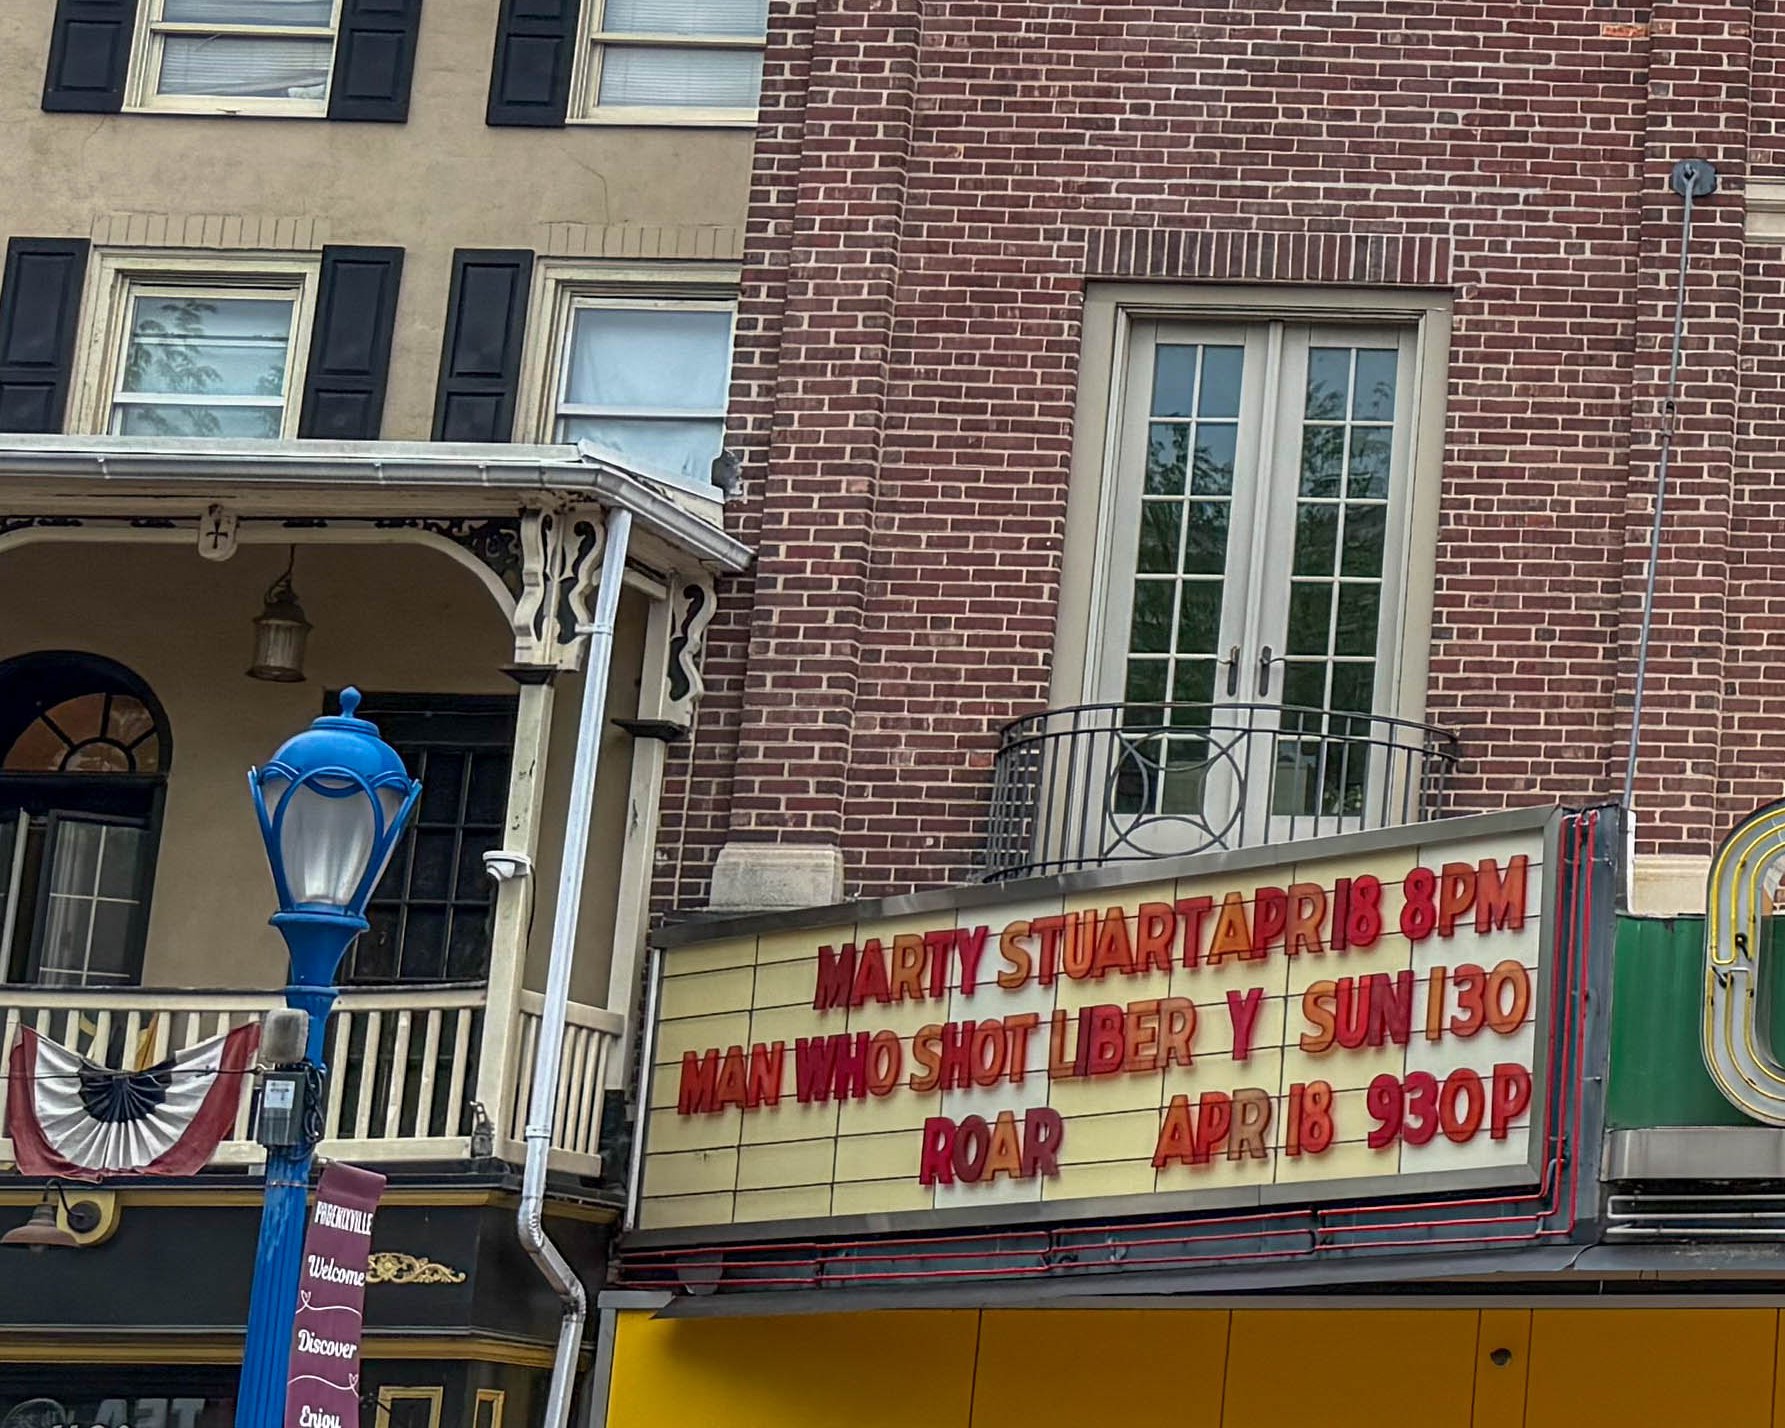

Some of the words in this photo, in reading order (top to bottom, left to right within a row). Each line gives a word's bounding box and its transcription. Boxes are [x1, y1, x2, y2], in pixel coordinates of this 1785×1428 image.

[813, 924, 988, 1010] MARTY
[1400, 855, 1529, 939] 8PM
[678, 1040, 785, 1115] MAN
[795, 1030, 902, 1103] WHO
[910, 1012, 1040, 1092] SHOT
[1300, 970, 1414, 1053] SUN
[1425, 960, 1531, 1041] 130
[919, 1107, 1064, 1185] ROAR
[1152, 1088, 1271, 1167] APR
[1285, 1080, 1333, 1156] 18
[308, 1254, 365, 1287] Welcome
[298, 1329, 357, 1359] Discover
